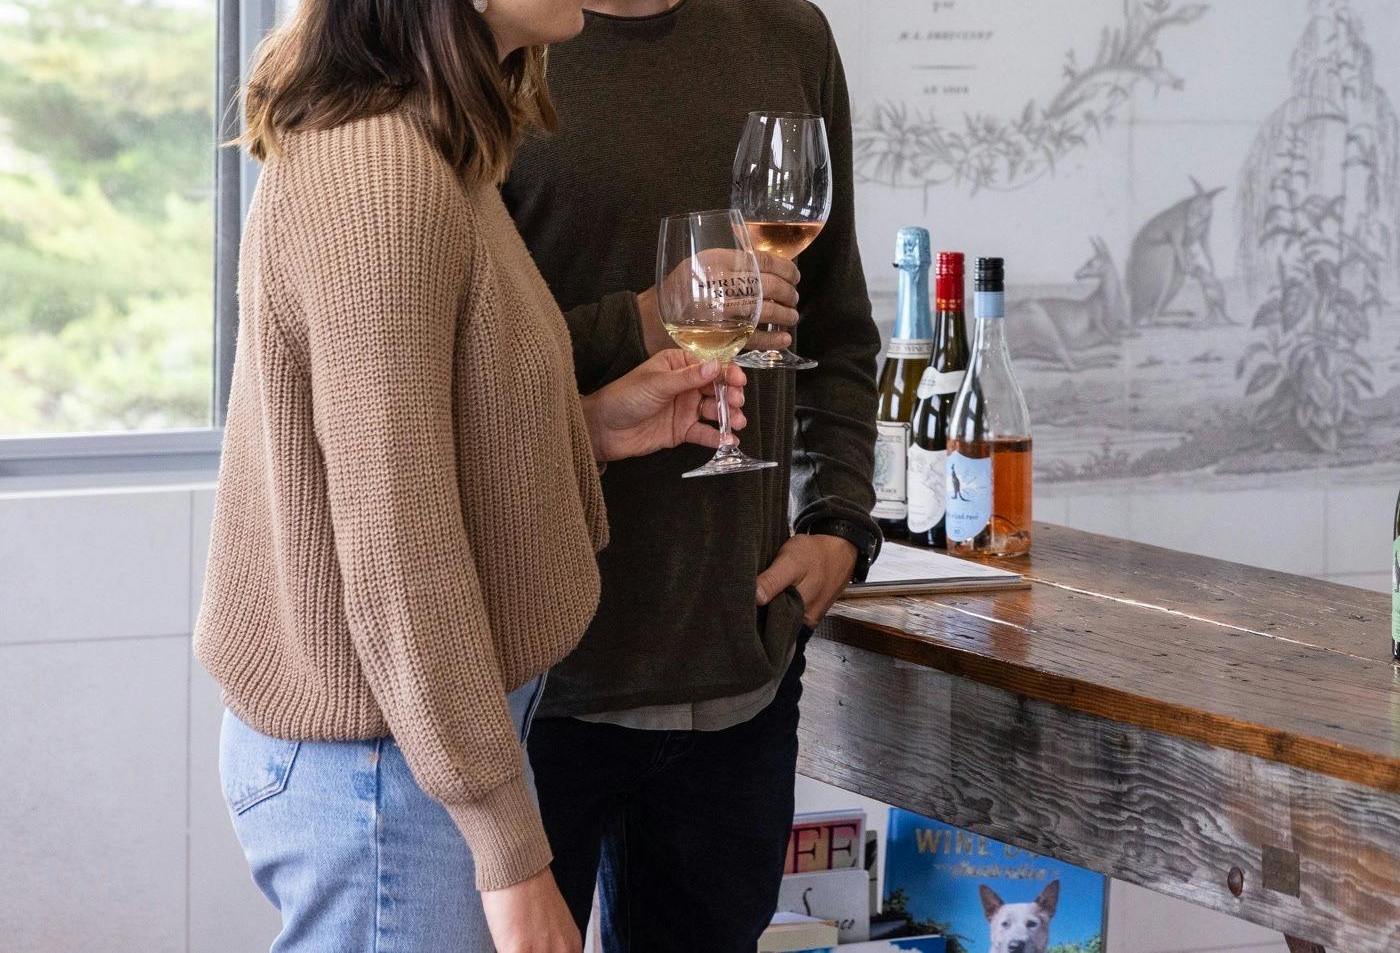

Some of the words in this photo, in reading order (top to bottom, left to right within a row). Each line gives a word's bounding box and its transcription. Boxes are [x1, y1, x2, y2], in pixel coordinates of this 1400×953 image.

[699, 276, 759, 289] SPRINGS
[714, 287, 754, 298] ROAD
[915, 828, 990, 856] WINE
